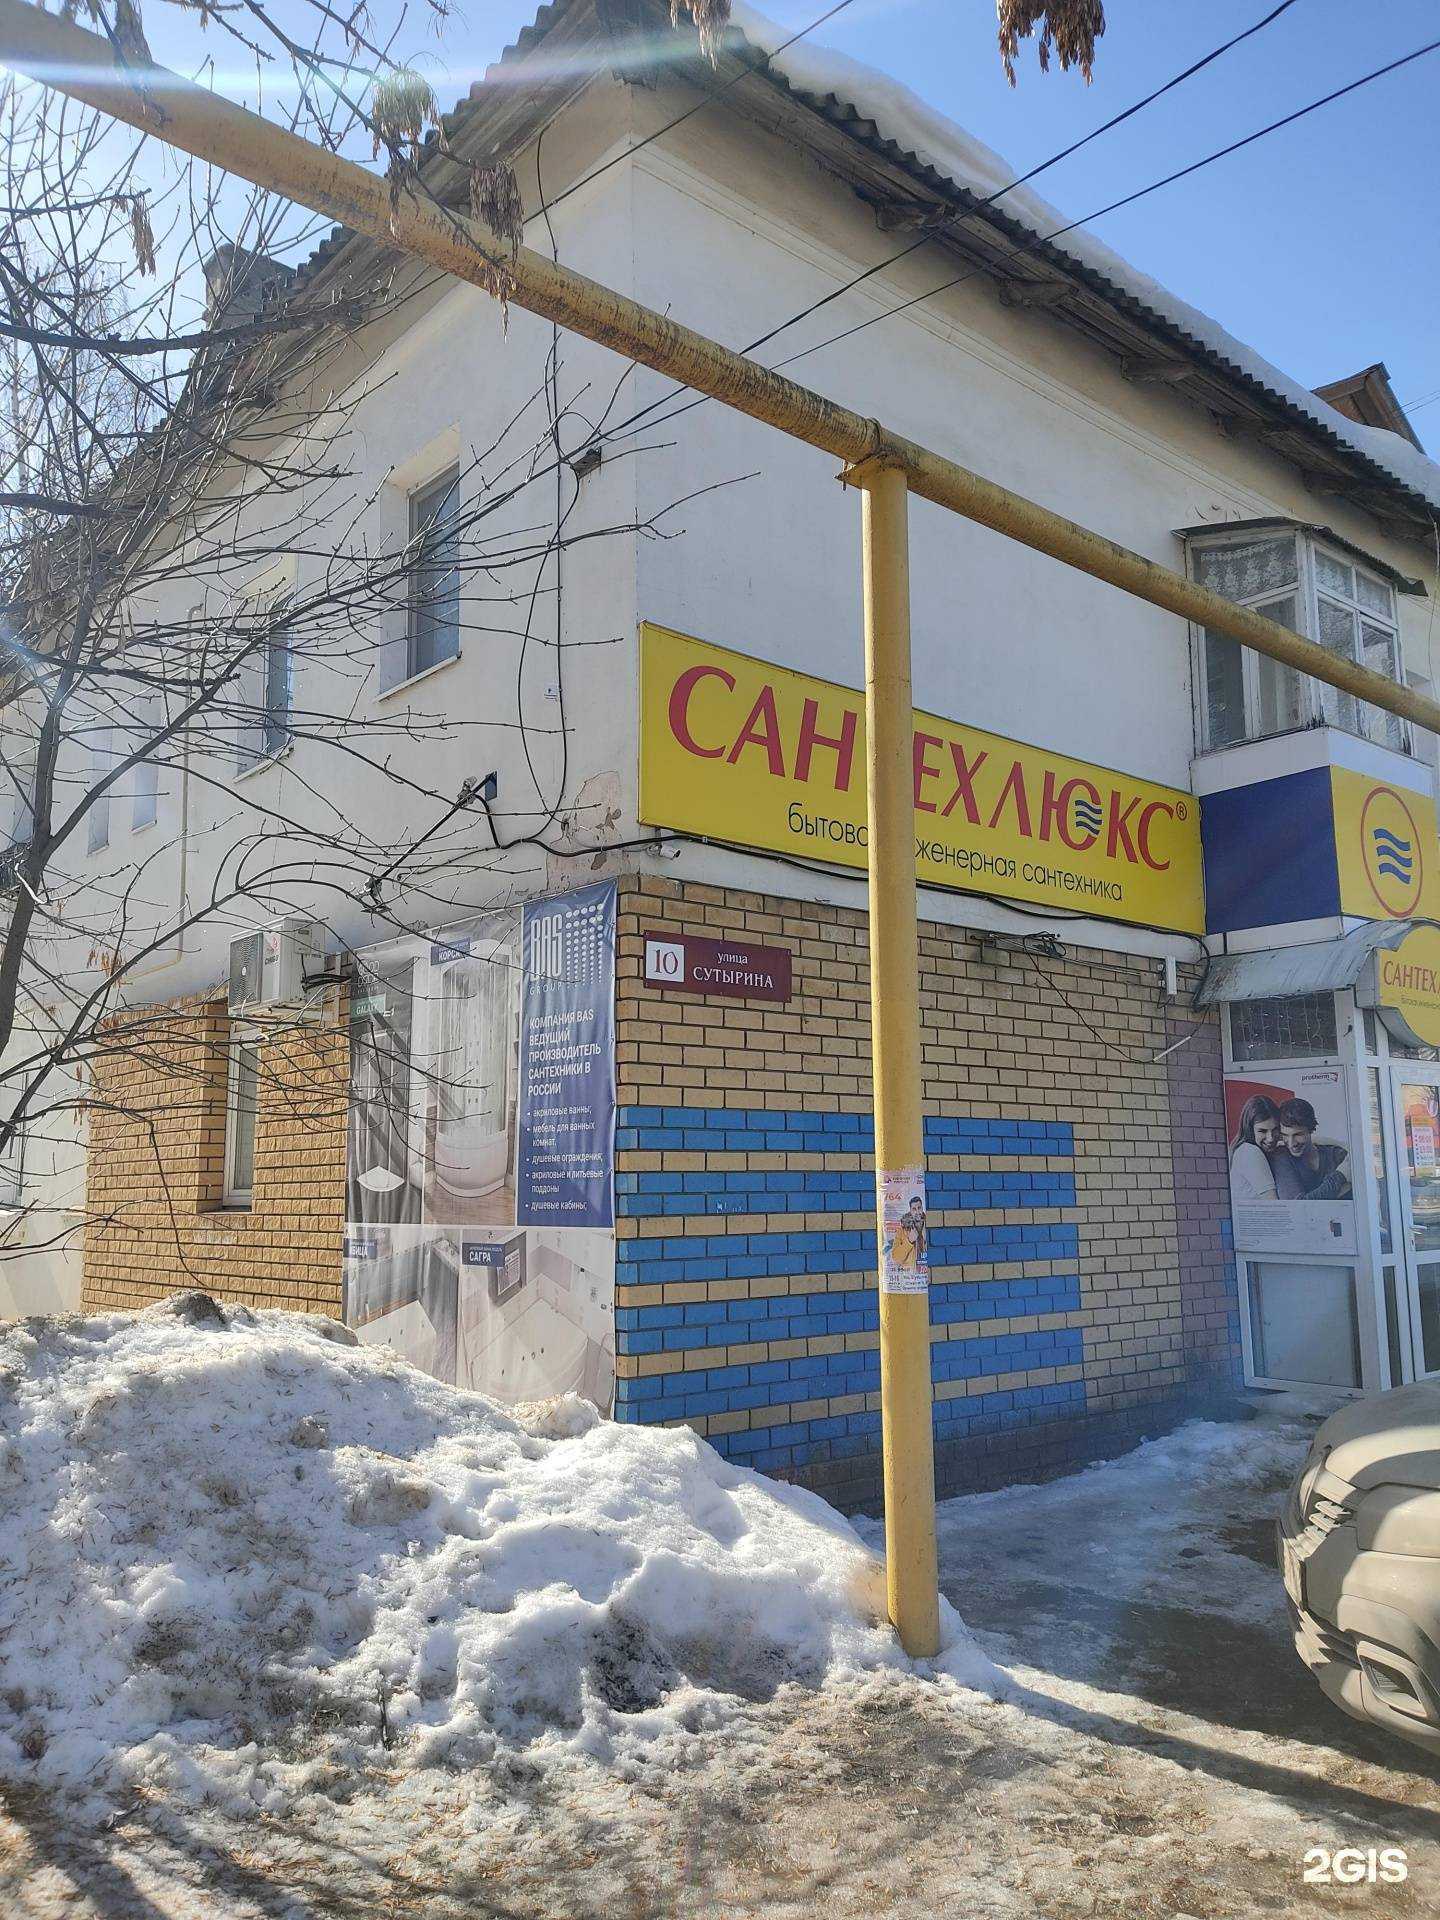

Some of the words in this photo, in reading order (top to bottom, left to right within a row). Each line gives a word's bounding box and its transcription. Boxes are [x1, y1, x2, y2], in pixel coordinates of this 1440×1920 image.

[914, 838, 1017, 878] женерная
[1022, 862, 1123, 901] сантехника
[530, 913, 563, 982] BAS
[655, 949, 679, 975] 10
[717, 952, 748, 965] улица
[693, 966, 774, 989] СУТЫРИНА
[529, 982, 562, 995] GROUP
[529, 1011, 576, 1030] КОМПАНИЯ
[576, 1008, 594, 1023] BAS
[529, 1027, 570, 1047] ВЕДУЩИЙ
[528, 1042, 602, 1063] ПРОИЗВОДИТЕЛЬ
[528, 1062, 583, 1080] САНТЕХНИКИ
[584, 1061, 591, 1074] В
[527, 1082, 561, 1097] РОССИИ
[532, 1107, 568, 1118] акриловые
[532, 1122, 556, 1134] мебель
[556, 1123, 569, 1133] для
[569, 1121, 596, 1131] ванных
[531, 1154, 561, 1165] душевые
[531, 1171, 566, 1182] акриловые
[531, 1185, 560, 1195] поддоны
[530, 1202, 560, 1212] душевые
[469, 1250, 492, 1263] САГРА
